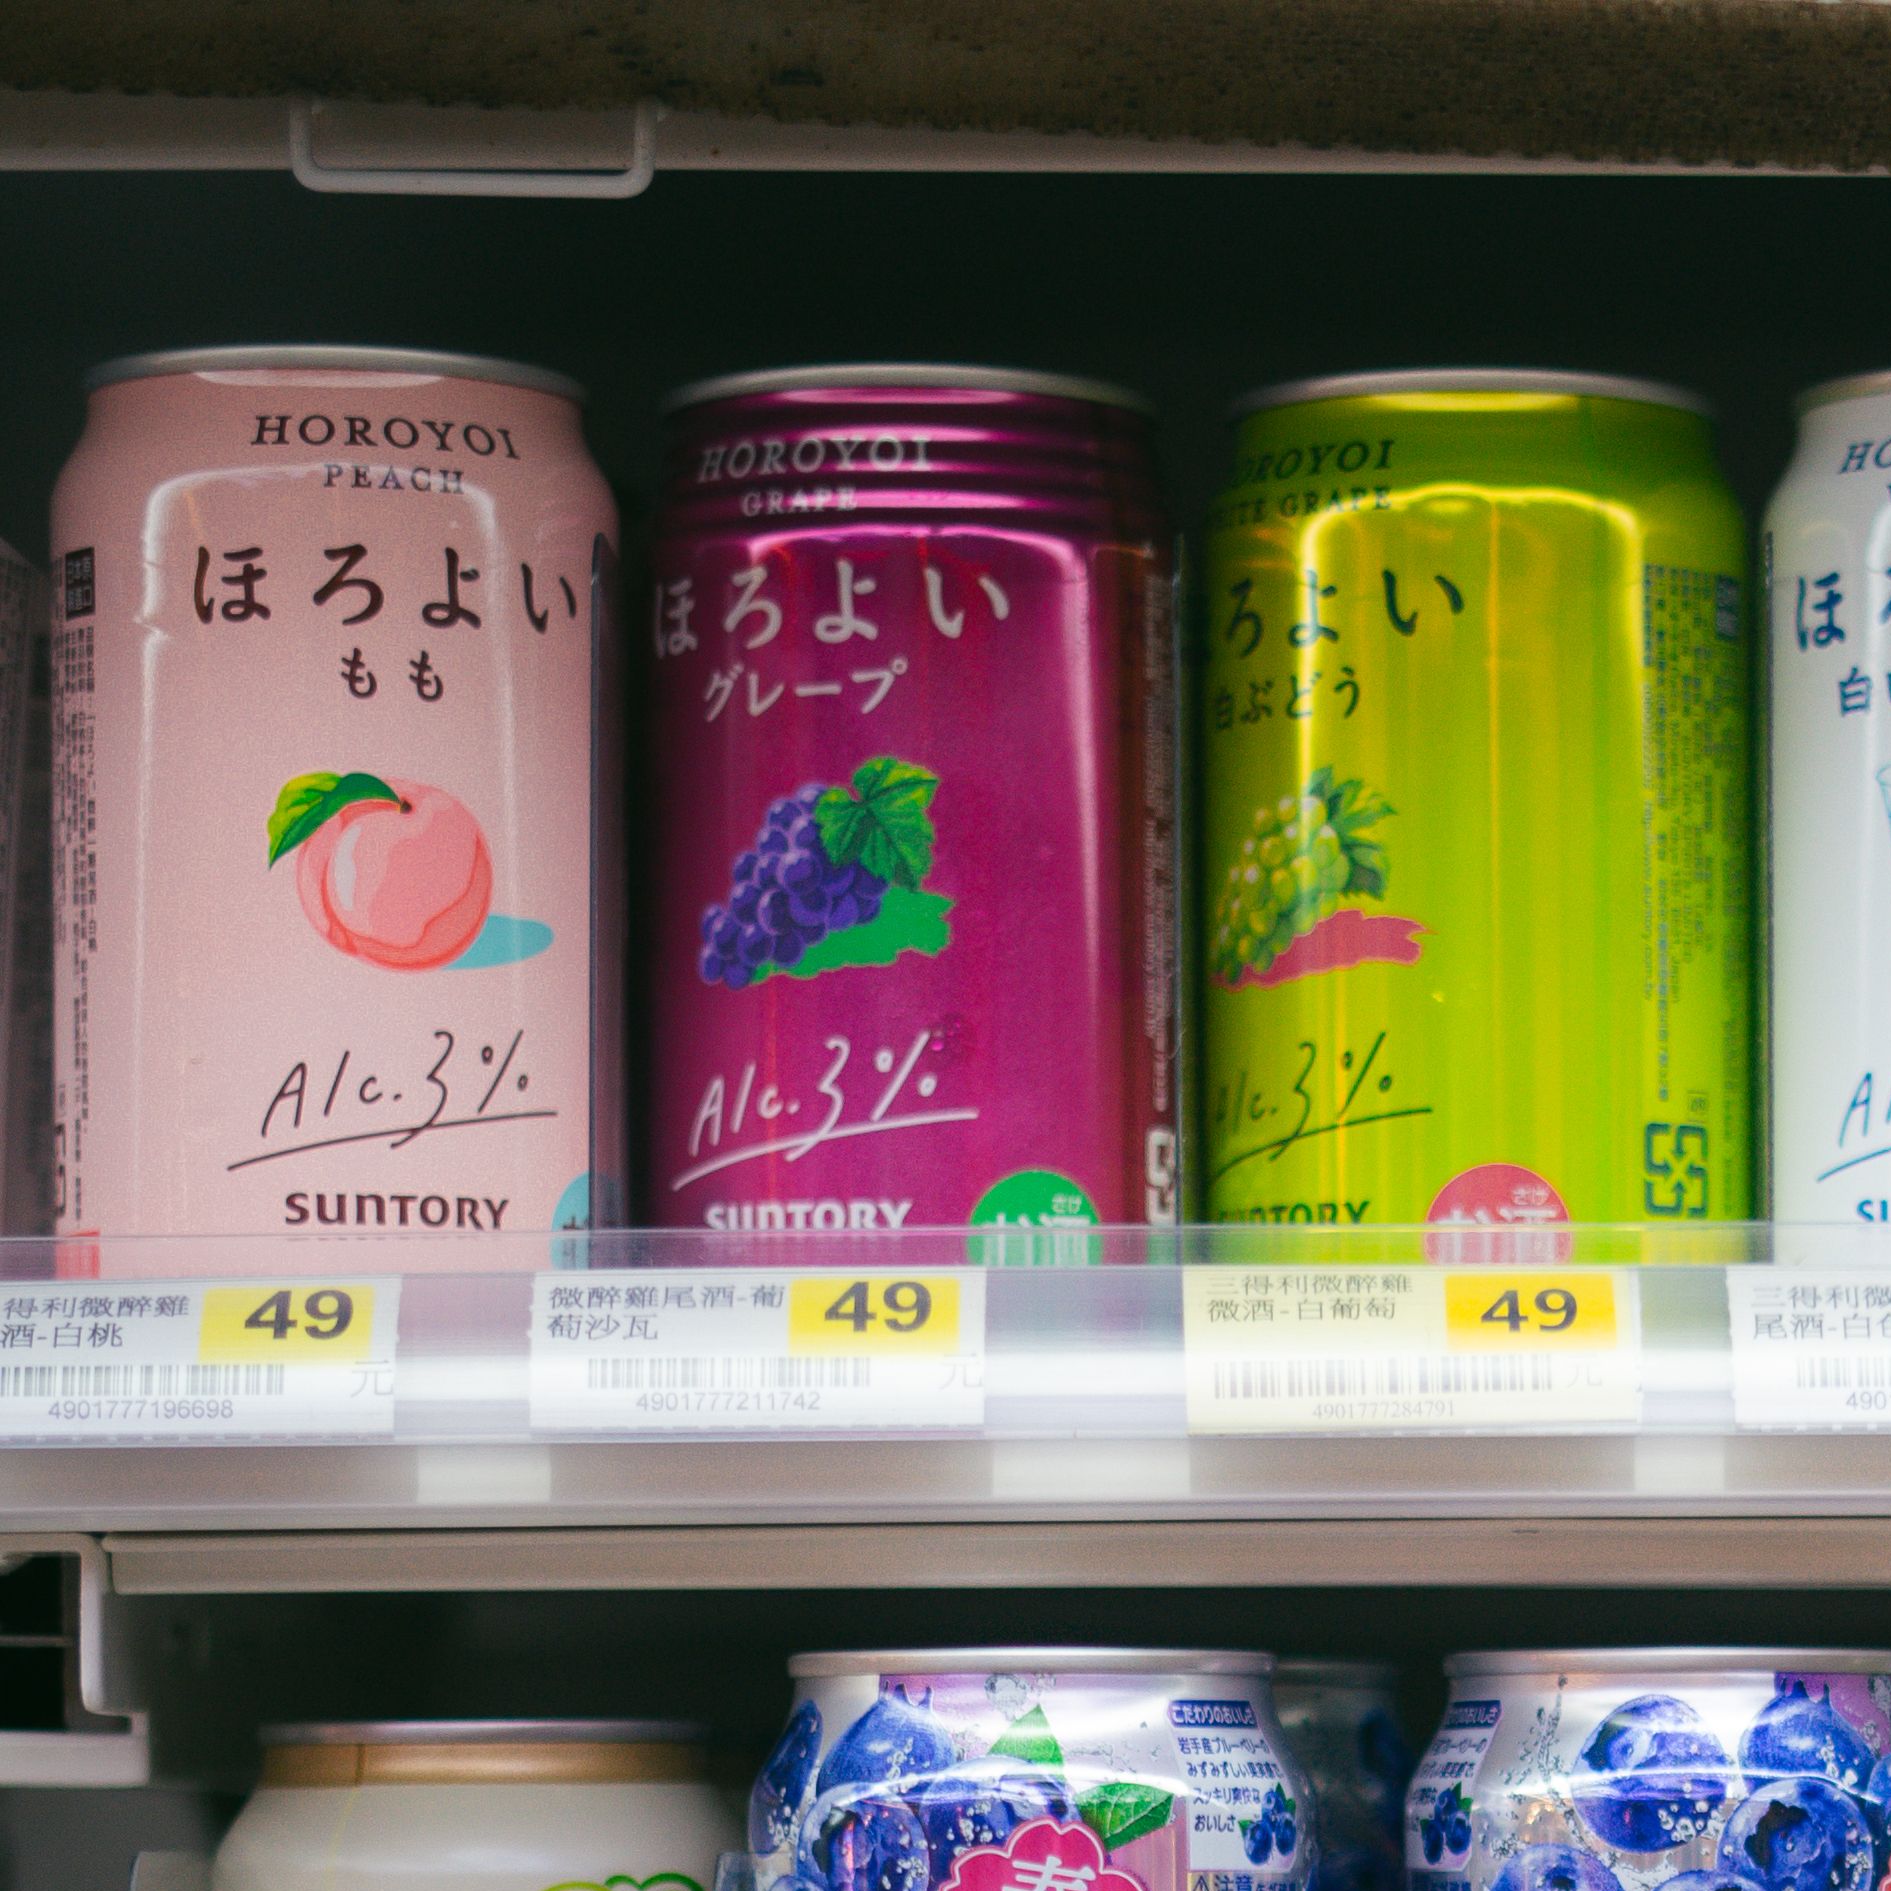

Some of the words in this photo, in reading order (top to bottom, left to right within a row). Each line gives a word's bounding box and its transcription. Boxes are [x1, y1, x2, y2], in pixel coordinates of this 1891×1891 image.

[250, 412, 522, 461] HOROYOI
[696, 434, 936, 484] HOROYOI
[322, 462, 467, 496] PEACH
[740, 484, 860, 518] GRAPE
[191, 540, 579, 635] ほろよい
[652, 558, 1011, 661] ほろよい
[340, 647, 445, 702] もも
[701, 657, 908, 724] グレープ
[284, 1190, 511, 1233] SUNTORY
[243, 1288, 355, 1341] 49
[823, 1280, 932, 1334] 49
[1479, 1286, 1579, 1334] 49
[47, 1399, 236, 1421] 4901777196698
[634, 1391, 822, 1412] 4901777211742
